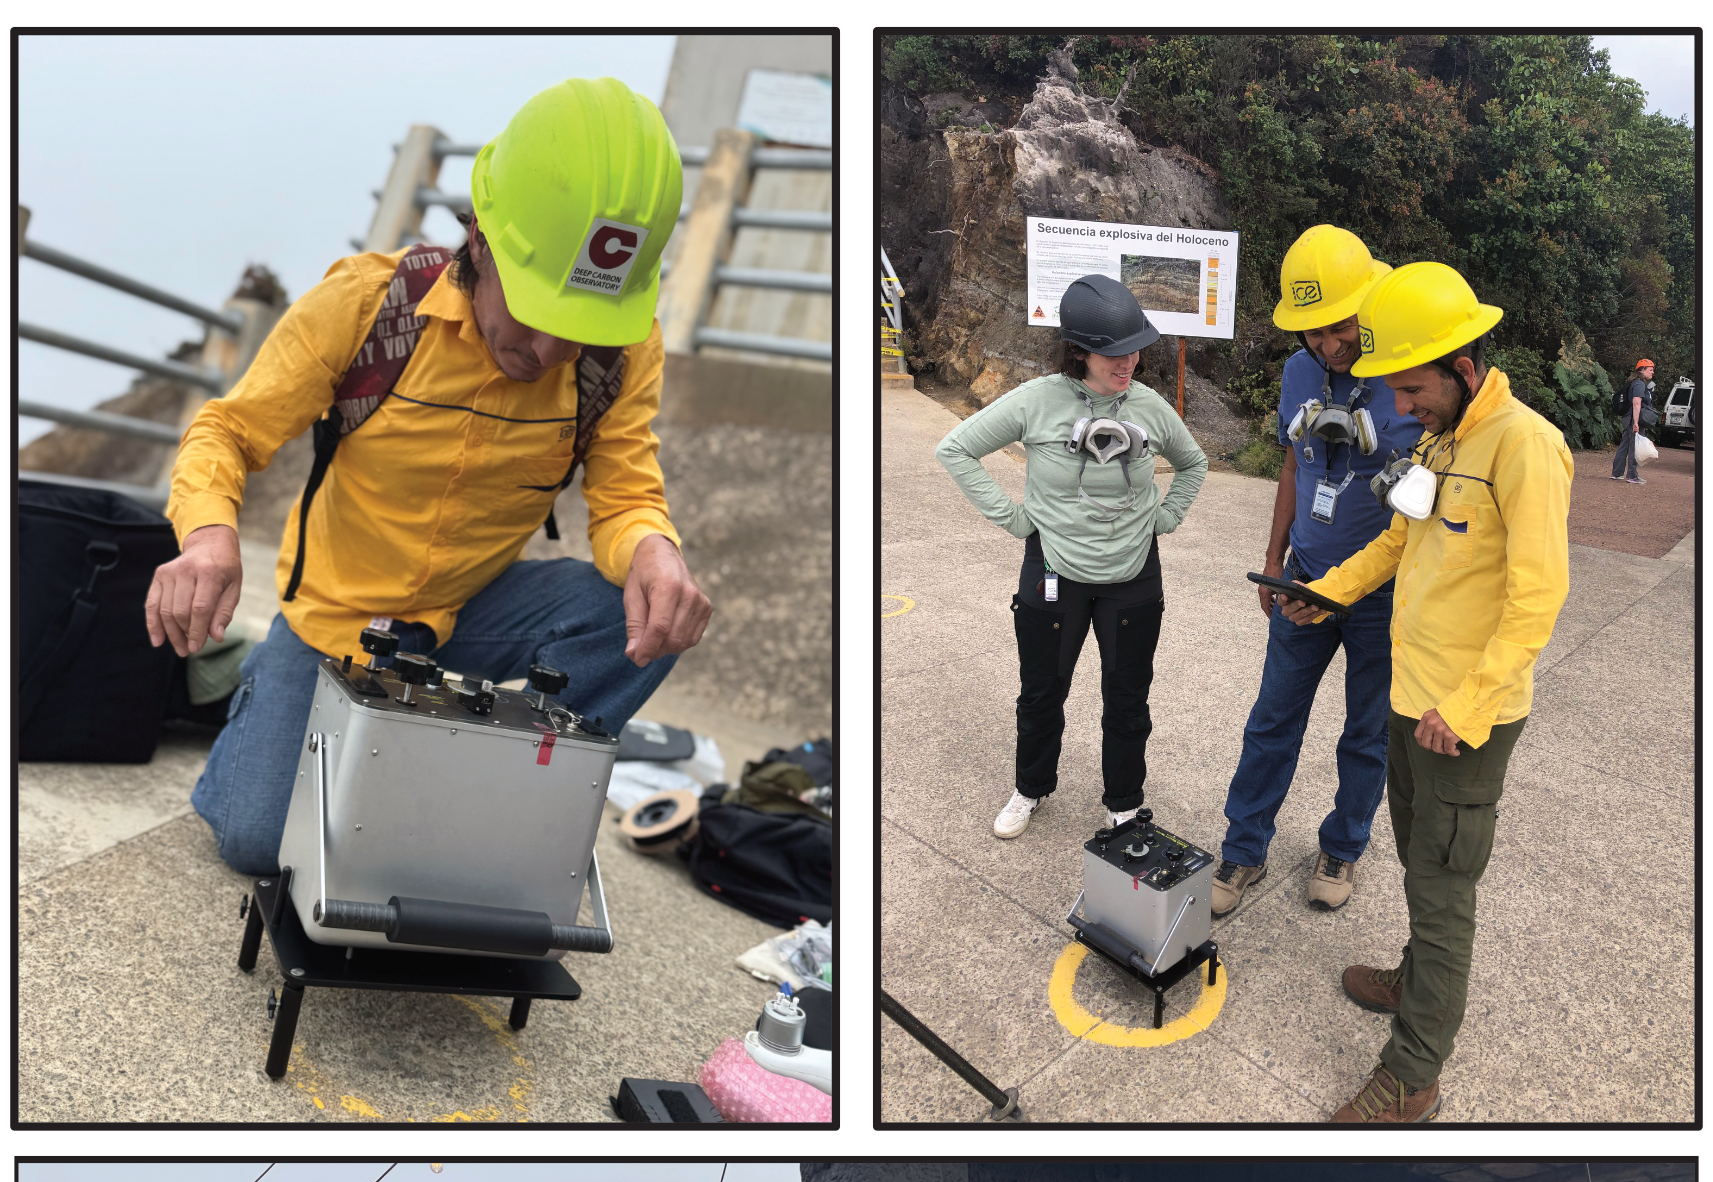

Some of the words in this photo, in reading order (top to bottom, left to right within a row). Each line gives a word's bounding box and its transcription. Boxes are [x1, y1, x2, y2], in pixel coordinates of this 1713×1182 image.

[1037, 222, 1096, 238] Secuencia
[1099, 228, 1153, 242] explosiva
[1156, 232, 1173, 243] del
[1176, 233, 1229, 247] Holoceno
[403, 251, 444, 271] TOTTO
[570, 275, 621, 291] OBSERVATORY
[573, 267, 593, 277] DEEP
[592, 271, 622, 284] CARBON
